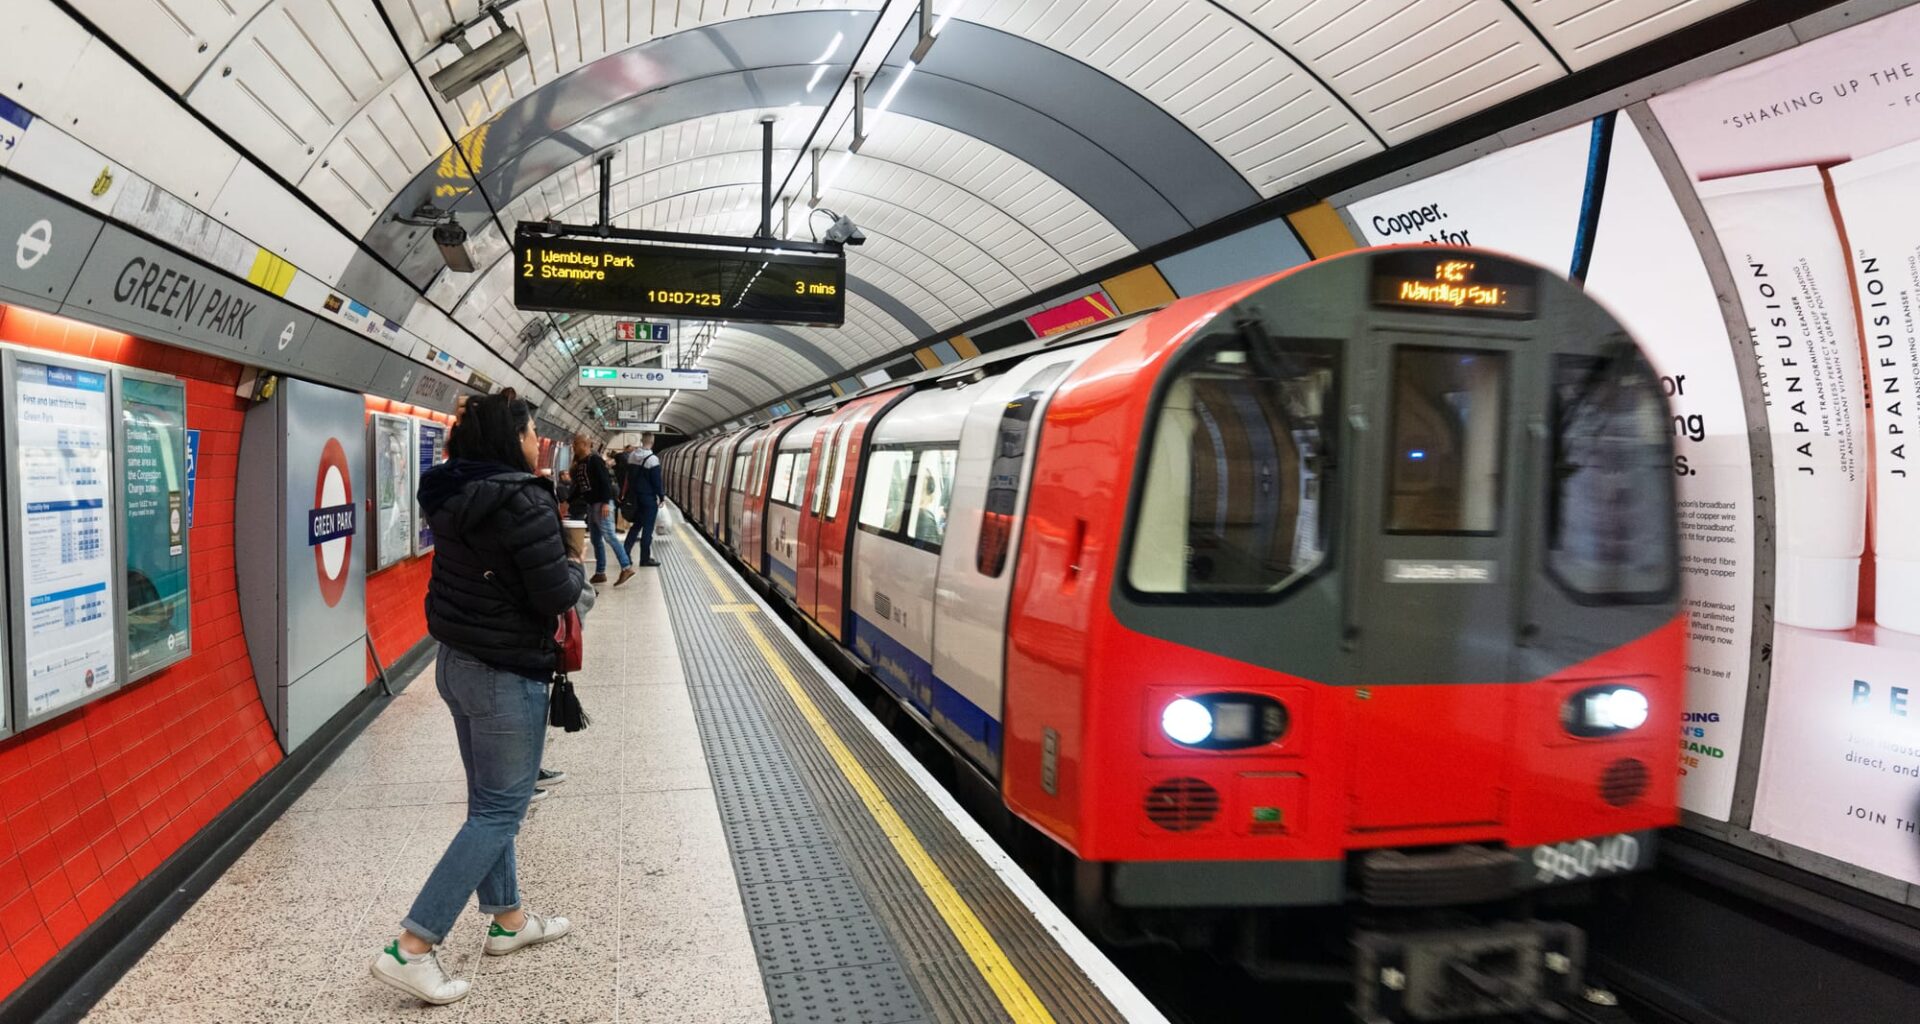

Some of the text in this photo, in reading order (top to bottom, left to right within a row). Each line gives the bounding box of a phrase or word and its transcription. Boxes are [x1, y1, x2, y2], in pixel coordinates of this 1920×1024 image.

[1833, 79, 1859, 97] UP
[1869, 63, 1914, 86] THE
[1372, 203, 1448, 237] Copper.
[524, 249, 635, 268] 1 Wembley Park
[523, 265, 605, 281] 2 Stanmore
[795, 281, 836, 295] 3 mins
[113, 257, 256, 339] GREEN PARK
[648, 290, 721, 306] 10:07:25
[1792, 297, 1830, 436] PURE TRANSFORMING CLEANSER
[1699, 501, 1736, 509] broadband
[314, 511, 353, 538] GREEN PARK
[1696, 513, 1719, 521] copper
[1710, 569, 1736, 577] copper
[1702, 601, 1735, 611] download
[1716, 625, 1735, 634] more
[1703, 667, 1711, 675] to
[1712, 670, 1725, 678] see
[1681, 713, 1720, 722] DING
[1681, 726, 1705, 738] N'S
[1679, 740, 1724, 759] BAND
[1845, 750, 1920, 778] direct, and
[1847, 805, 1920, 835] JOIN TH
